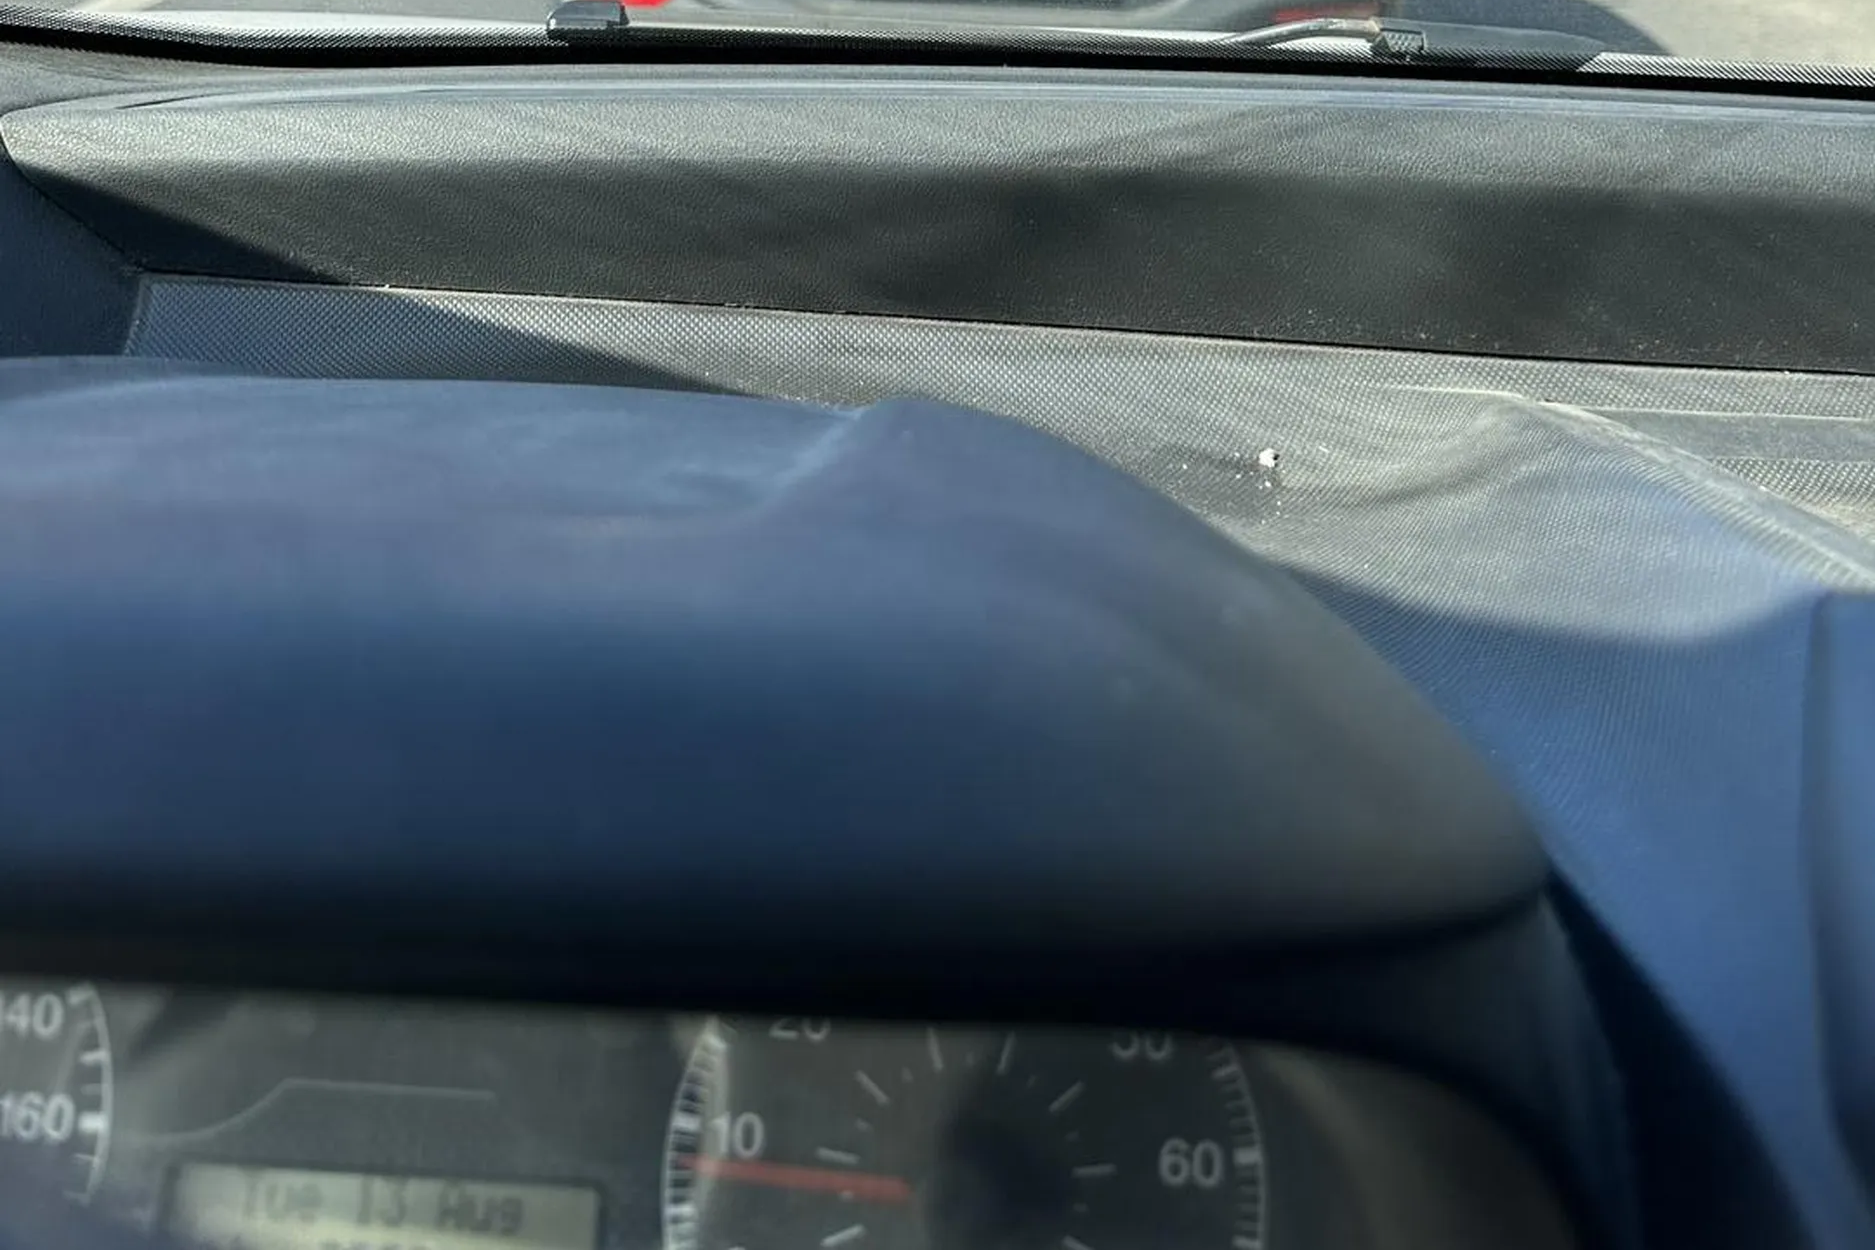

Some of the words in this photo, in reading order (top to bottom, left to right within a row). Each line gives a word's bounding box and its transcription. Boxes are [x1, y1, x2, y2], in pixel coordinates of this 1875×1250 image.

[0, 1091, 75, 1142] 160
[708, 1112, 765, 1159] 10
[1158, 1137, 1224, 1188] 60
